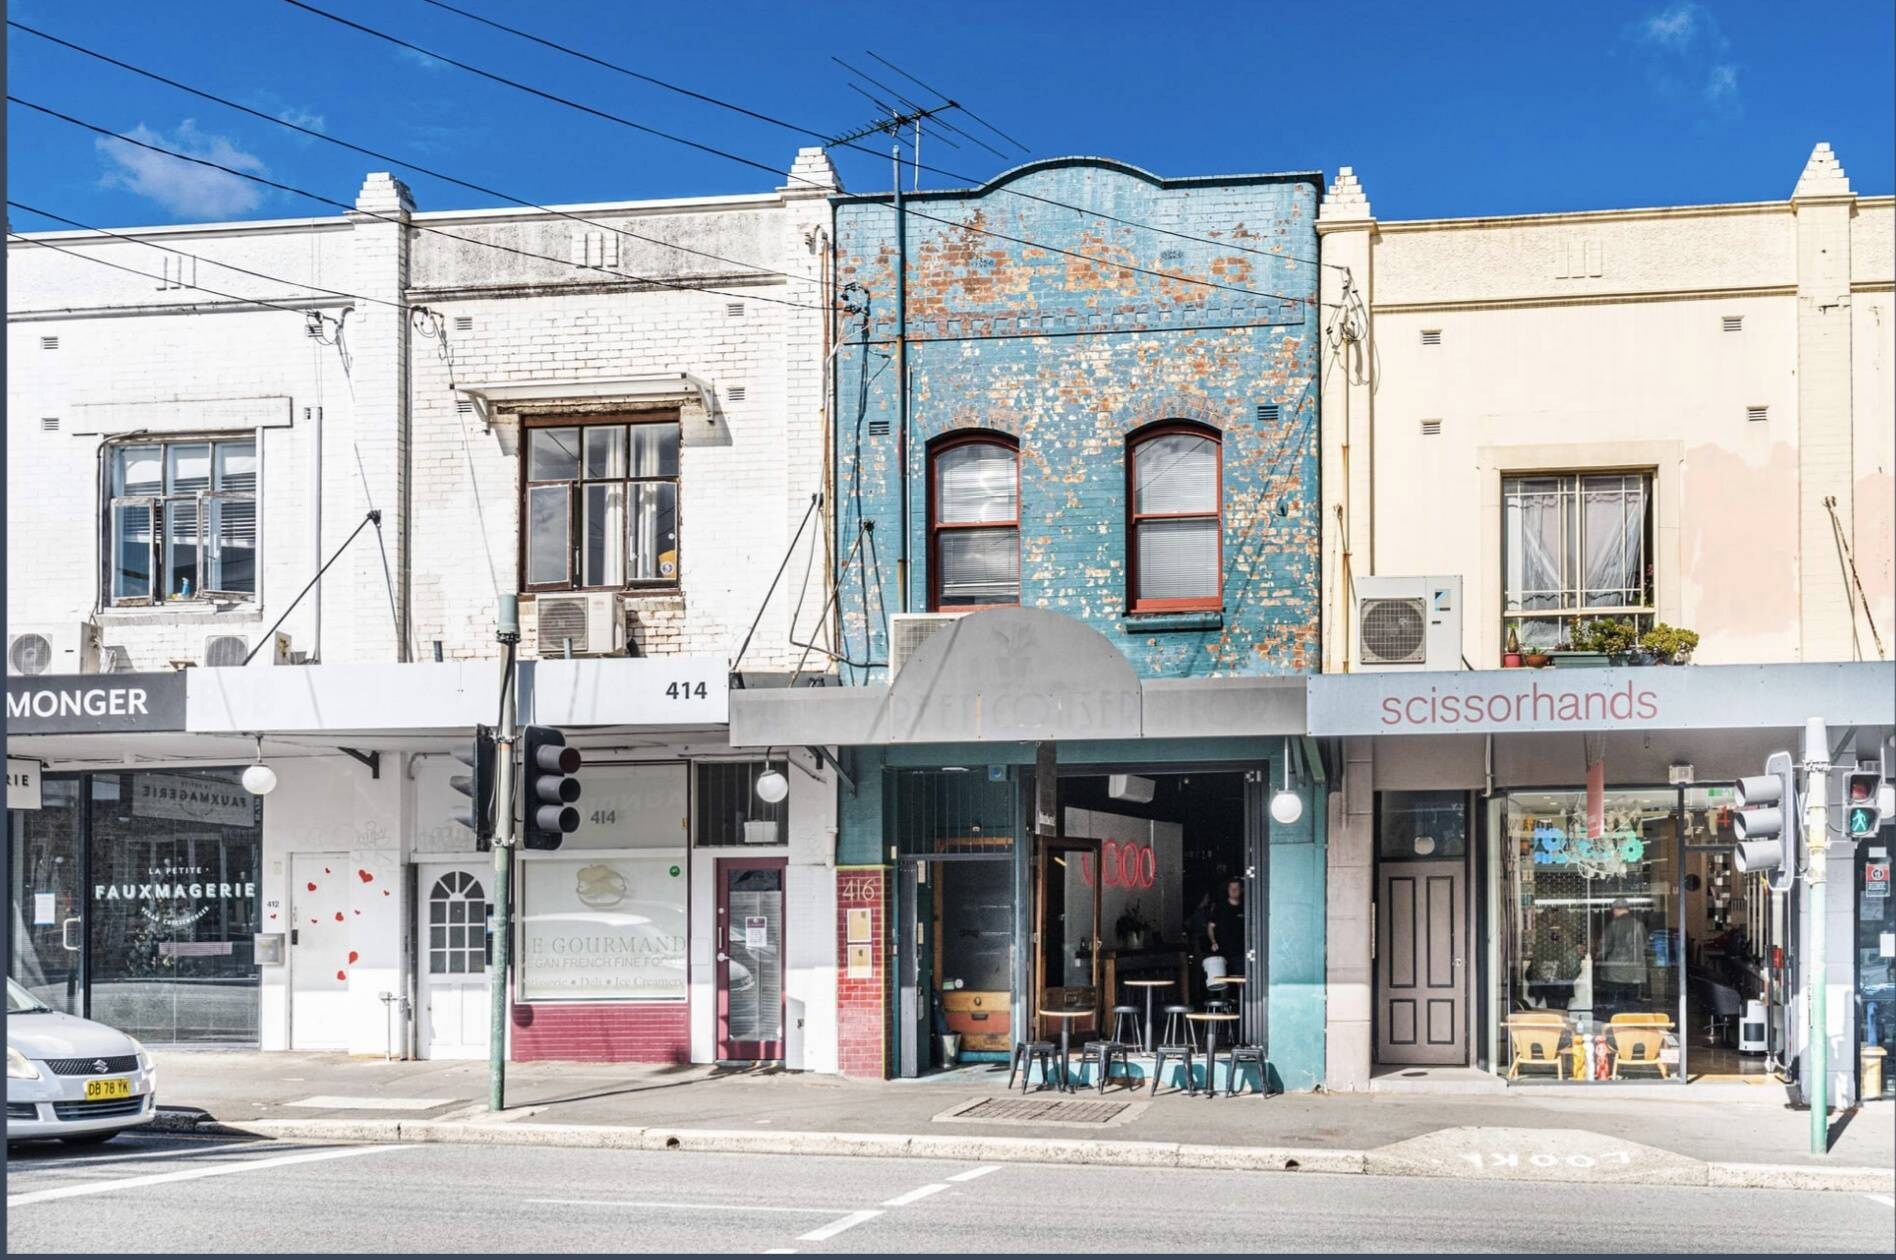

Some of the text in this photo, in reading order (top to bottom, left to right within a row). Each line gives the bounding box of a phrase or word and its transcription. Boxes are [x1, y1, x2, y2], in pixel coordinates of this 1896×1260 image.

[665, 681, 708, 700] 414
[7, 689, 149, 718] MONGER
[1381, 680, 1658, 725] scissorhands
[590, 810, 616, 824] 414
[149, 866, 202, 875] LA PETITE
[95, 883, 256, 900] FAUXMAGERIE
[842, 879, 875, 900] 416
[552, 936, 686, 954] GOURMAND
[527, 957, 560, 969] EGAN
[563, 957, 612, 968] FRENCH
[614, 956, 641, 968] FINE
[88, 1082, 101, 1096] DB
[104, 1082, 115, 1095] 78
